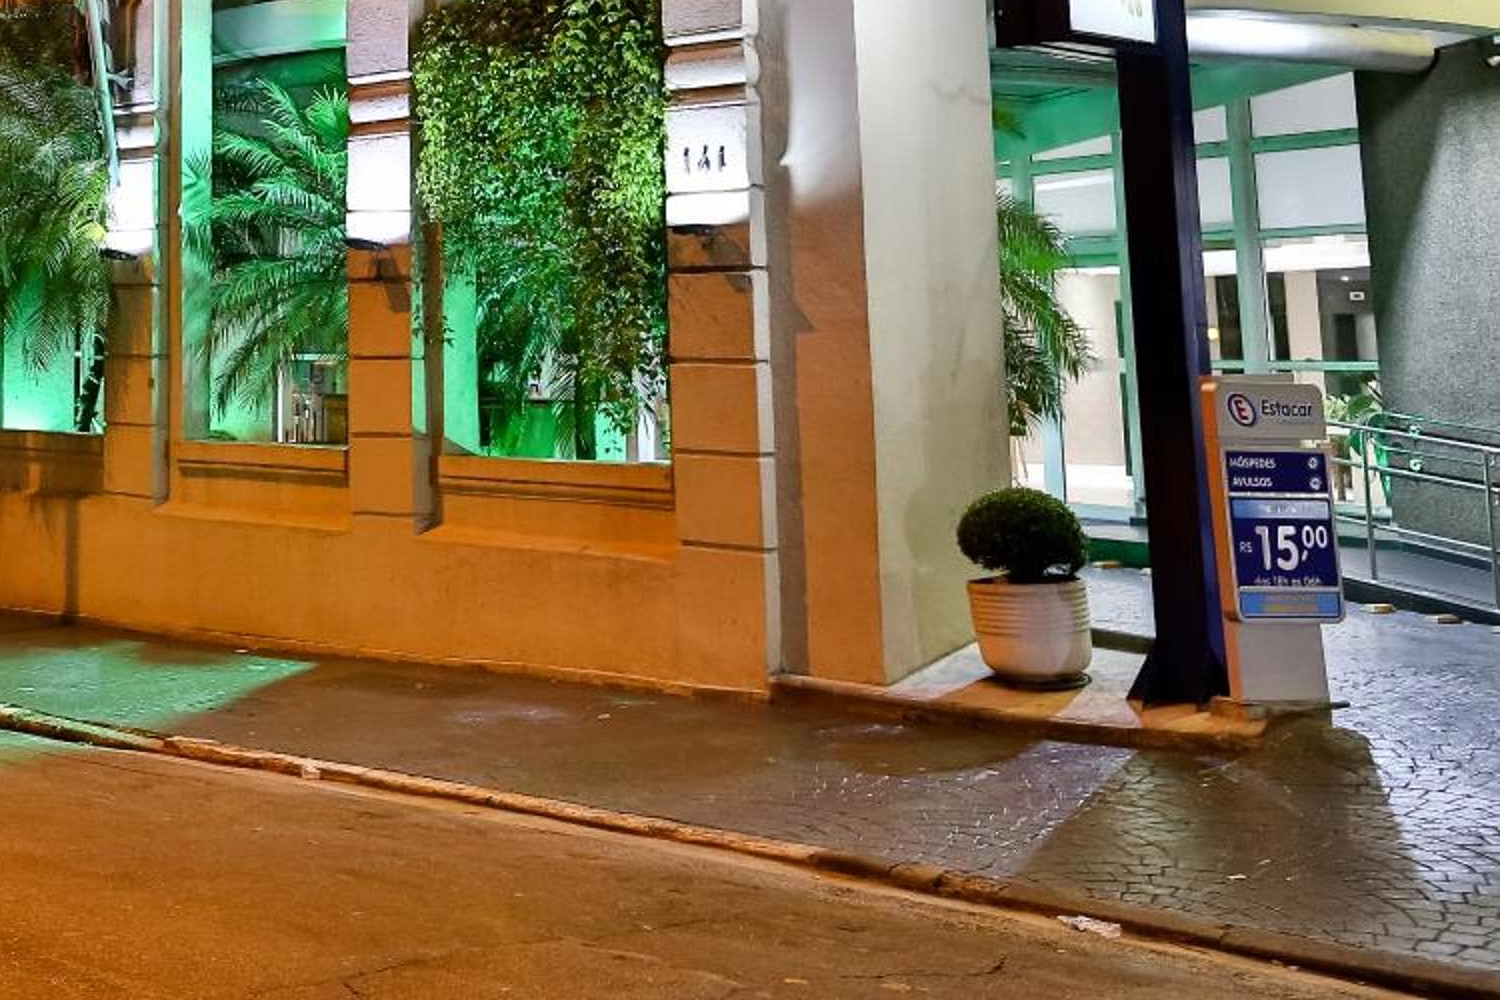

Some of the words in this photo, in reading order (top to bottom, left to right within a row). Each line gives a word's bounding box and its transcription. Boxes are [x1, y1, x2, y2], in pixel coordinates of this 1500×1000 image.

[1235, 400, 1248, 419] E
[1261, 399, 1313, 417] Estacar
[1232, 476, 1273, 488] AVULSOS
